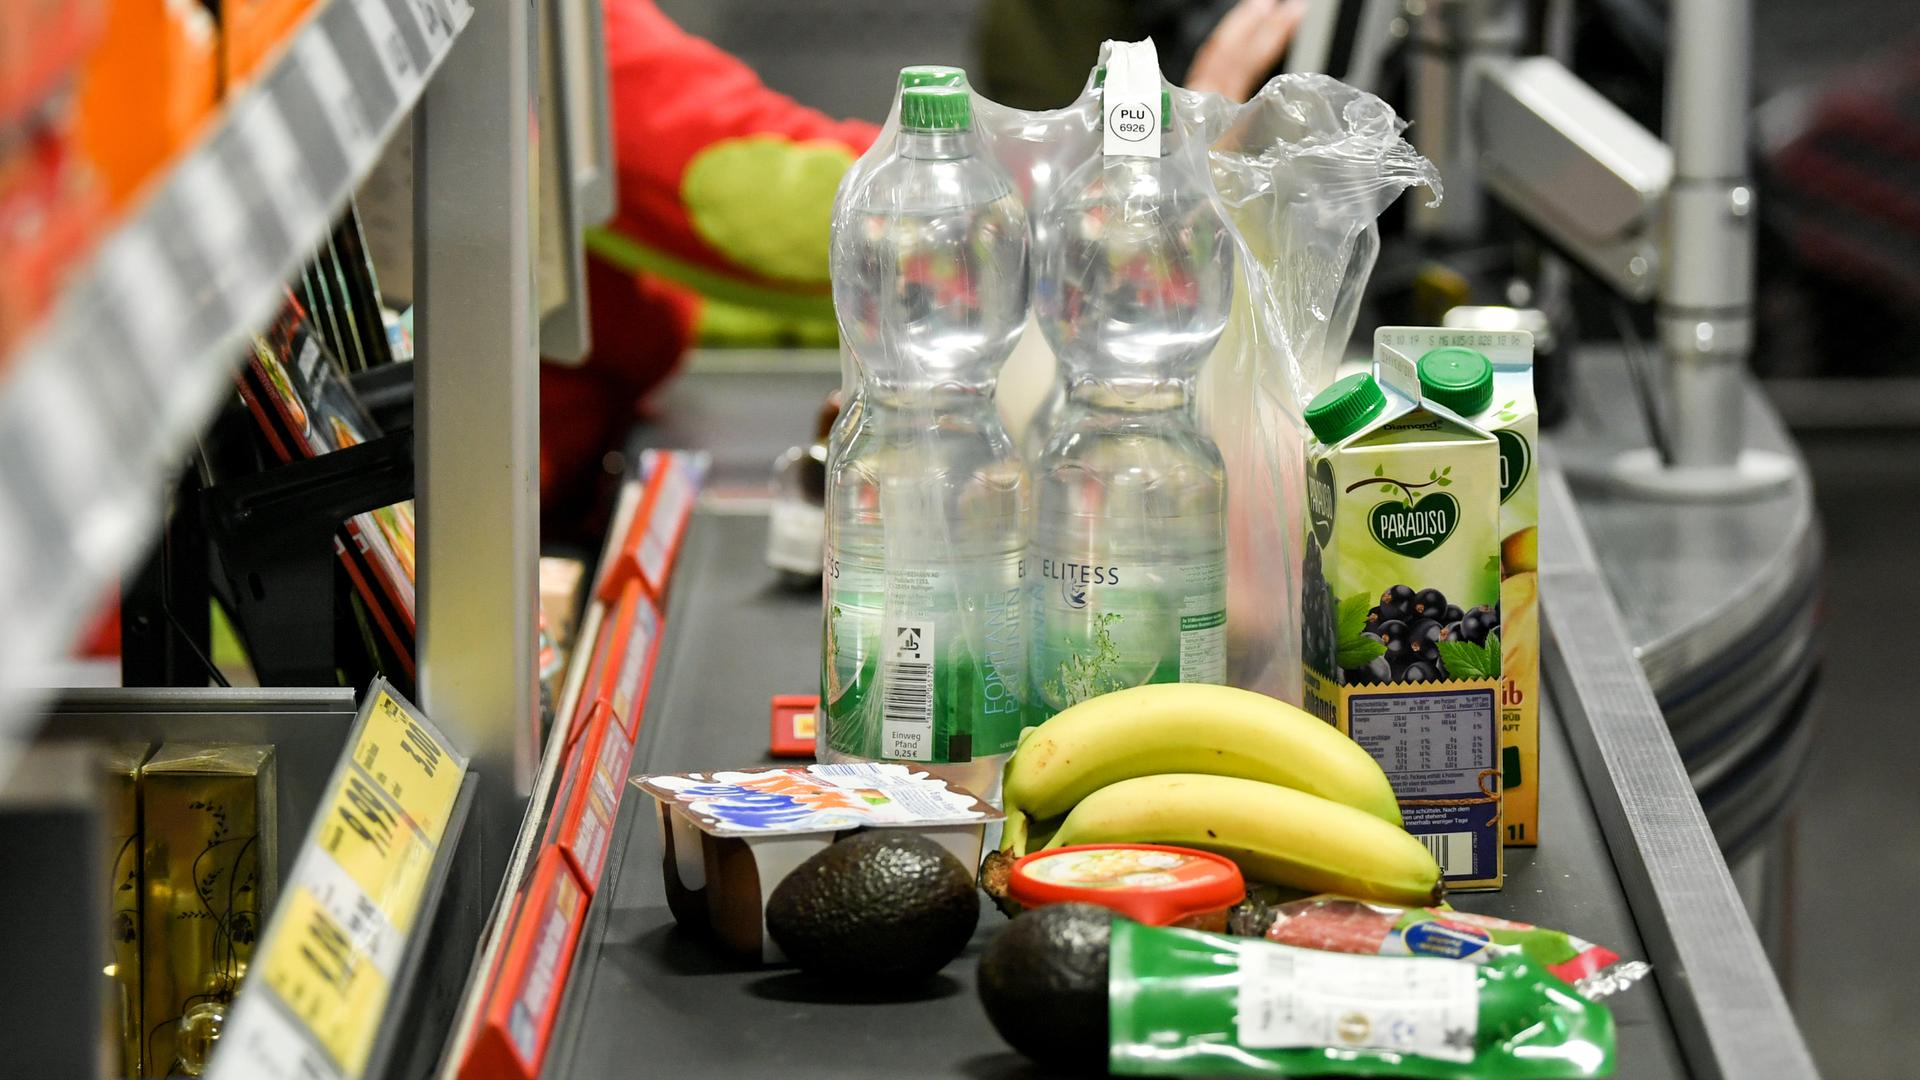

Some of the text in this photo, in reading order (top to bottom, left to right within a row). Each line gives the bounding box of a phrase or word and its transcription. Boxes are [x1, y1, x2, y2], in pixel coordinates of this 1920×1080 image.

[1121, 110, 1144, 119] PLU
[1120, 124, 1145, 132] 6926
[1380, 509, 1447, 539] PARADISO
[1043, 559, 1119, 585] ELITESS
[984, 592, 1005, 714] FONTANE
[1502, 712, 1520, 721] RÜB
[1502, 724, 1520, 732] AFT
[892, 732, 921, 741] Einweg
[895, 741, 918, 750] Pfand
